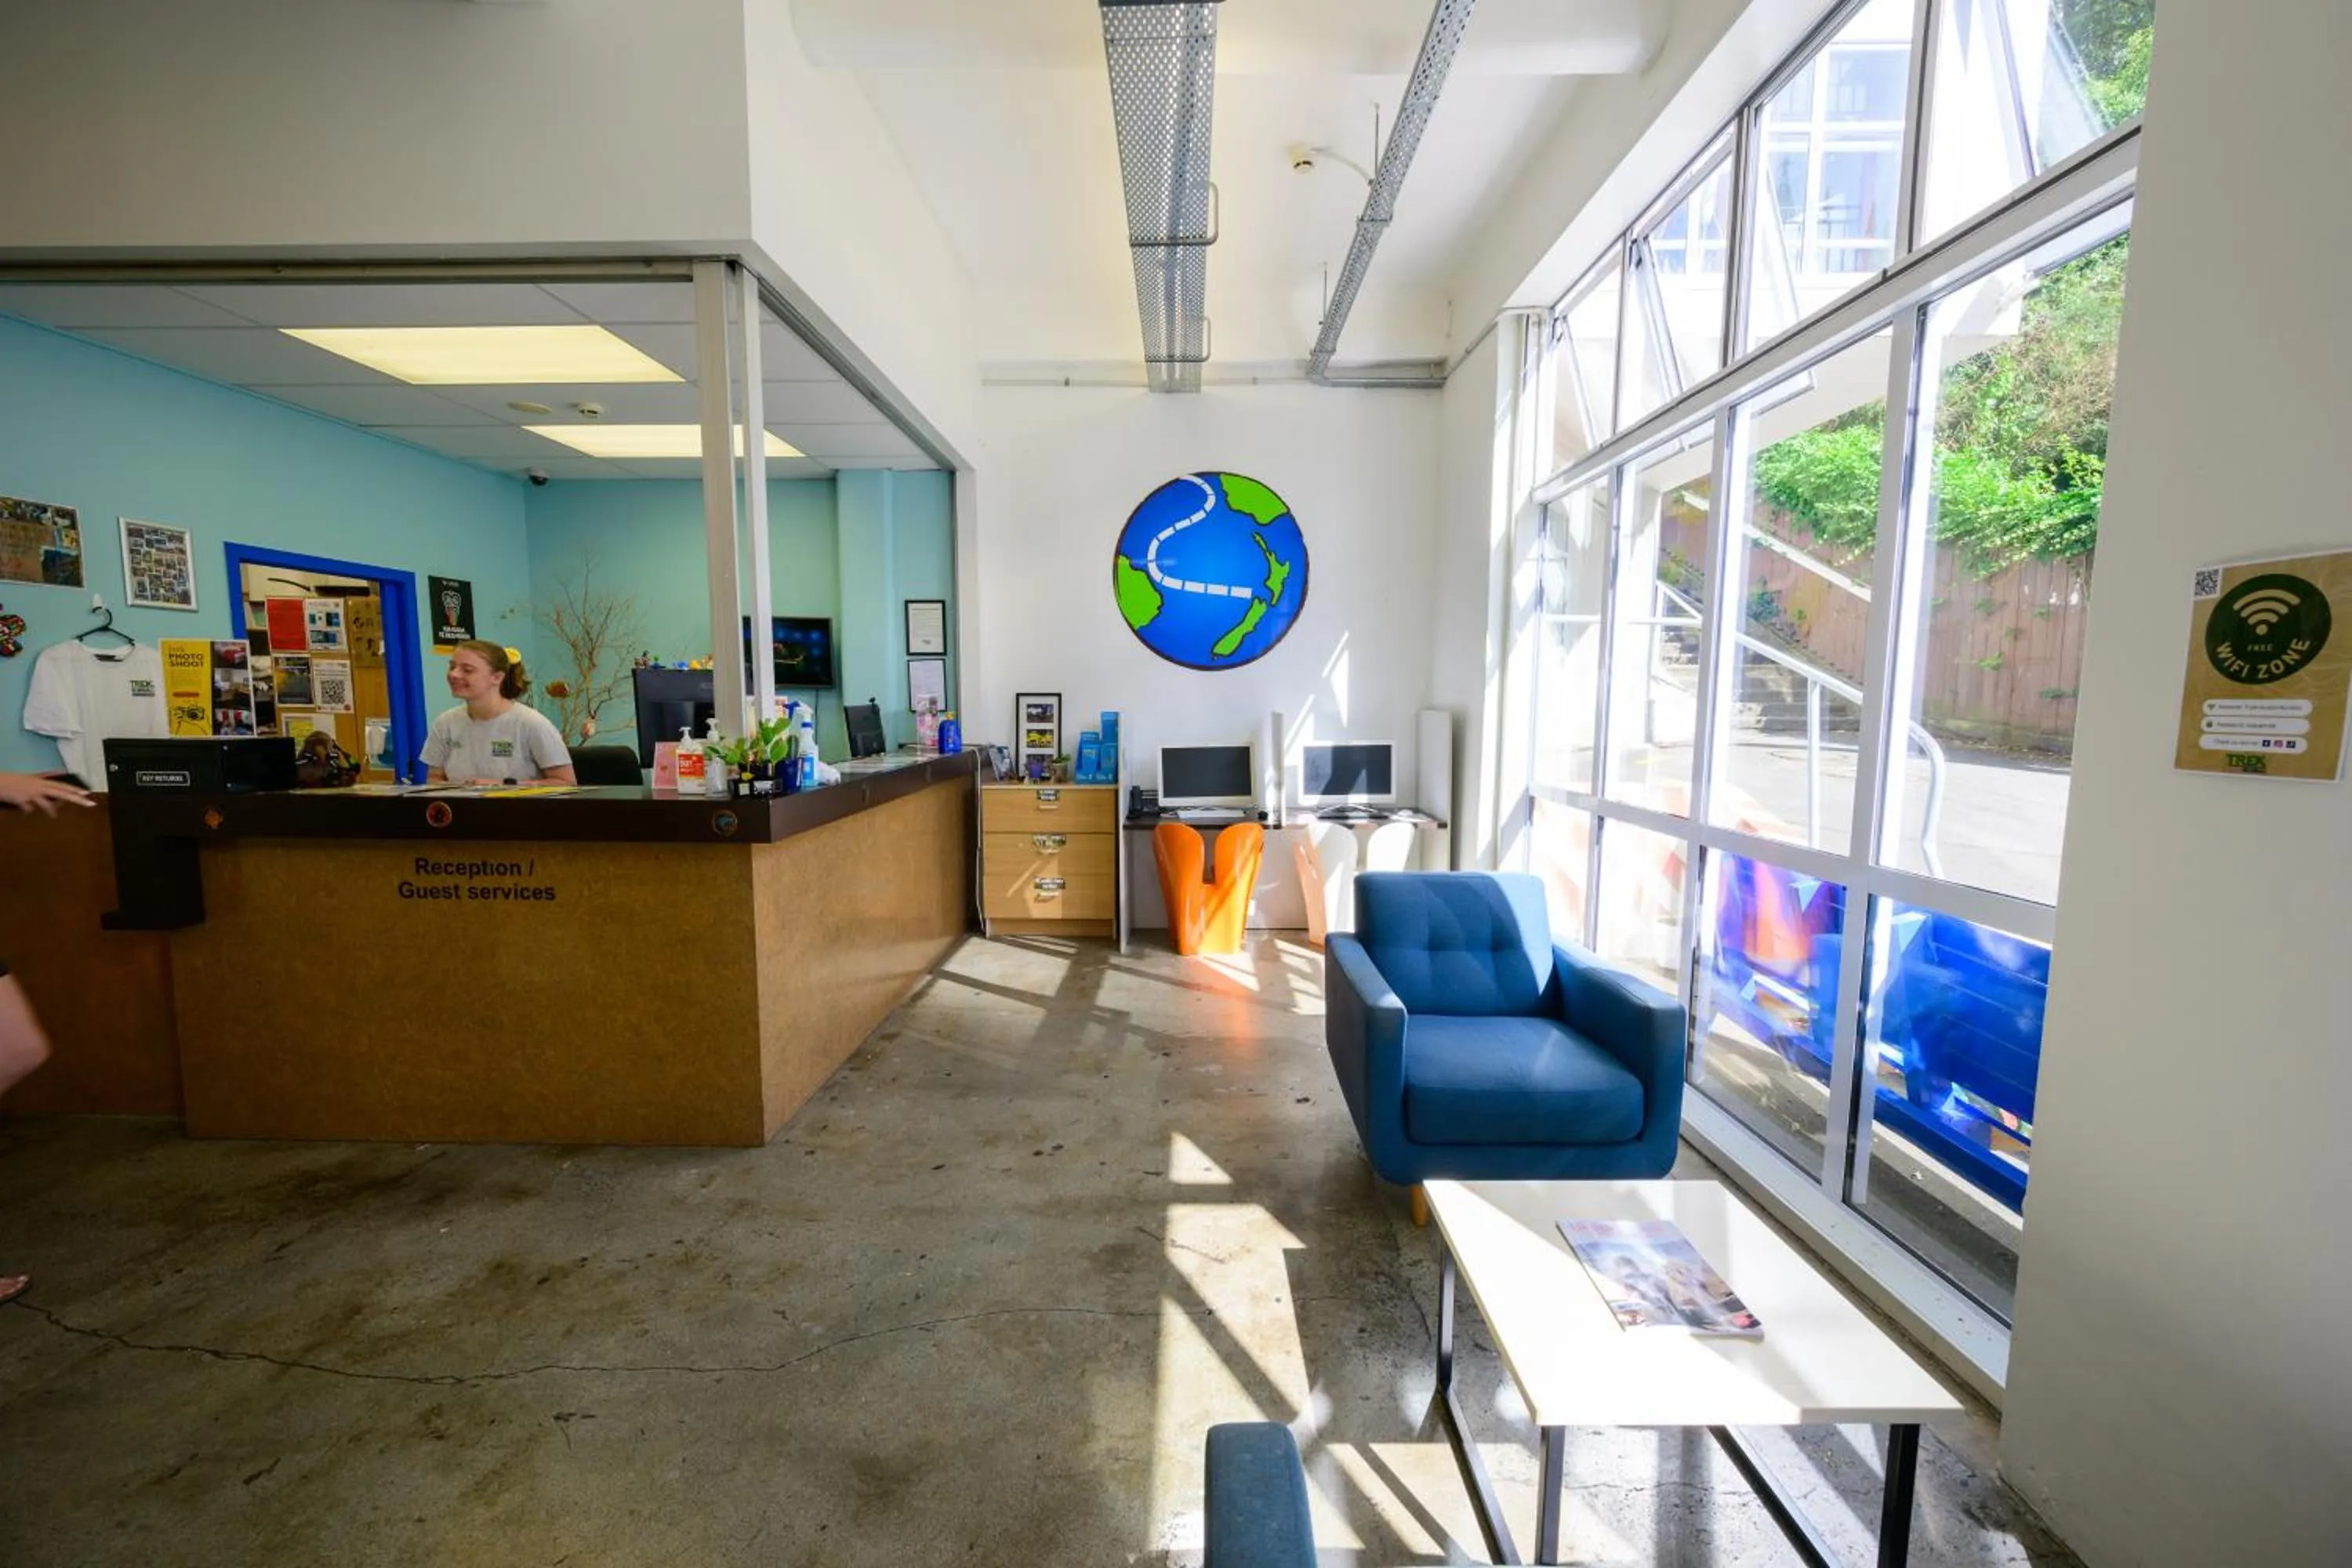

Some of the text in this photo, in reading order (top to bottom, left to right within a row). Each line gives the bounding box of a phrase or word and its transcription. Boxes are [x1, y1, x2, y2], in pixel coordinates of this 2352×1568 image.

[2216, 637, 2310, 679] WIFI ZONE
[2247, 643, 2273, 652] FREE
[415, 857, 535, 880] Reception /
[397, 880, 556, 901] Guest services
